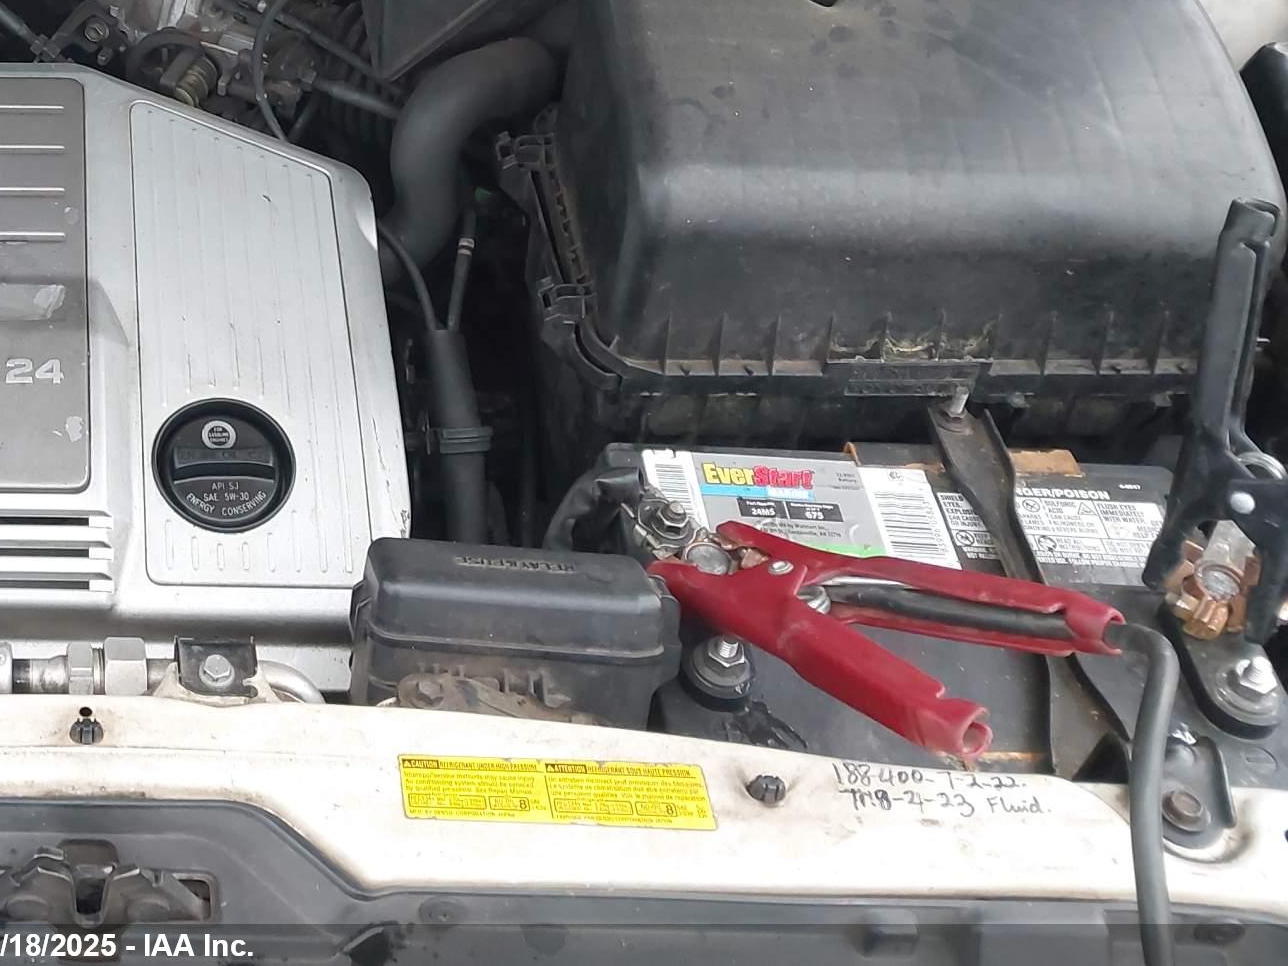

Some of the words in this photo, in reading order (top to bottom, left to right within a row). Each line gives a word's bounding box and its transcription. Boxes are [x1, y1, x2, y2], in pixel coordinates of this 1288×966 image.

[5, 358, 66, 385] 24
[703, 462, 814, 490] EverStart
[212, 482, 225, 490] API
[229, 482, 239, 490] SJ
[203, 493, 219, 502] SAE
[224, 492, 250, 501] 5W-30
[186, 492, 215, 514] ENERGY
[222, 490, 267, 516] CONSERVING
[751, 507, 776, 517] 24MS
[805, 510, 825, 521] 675
